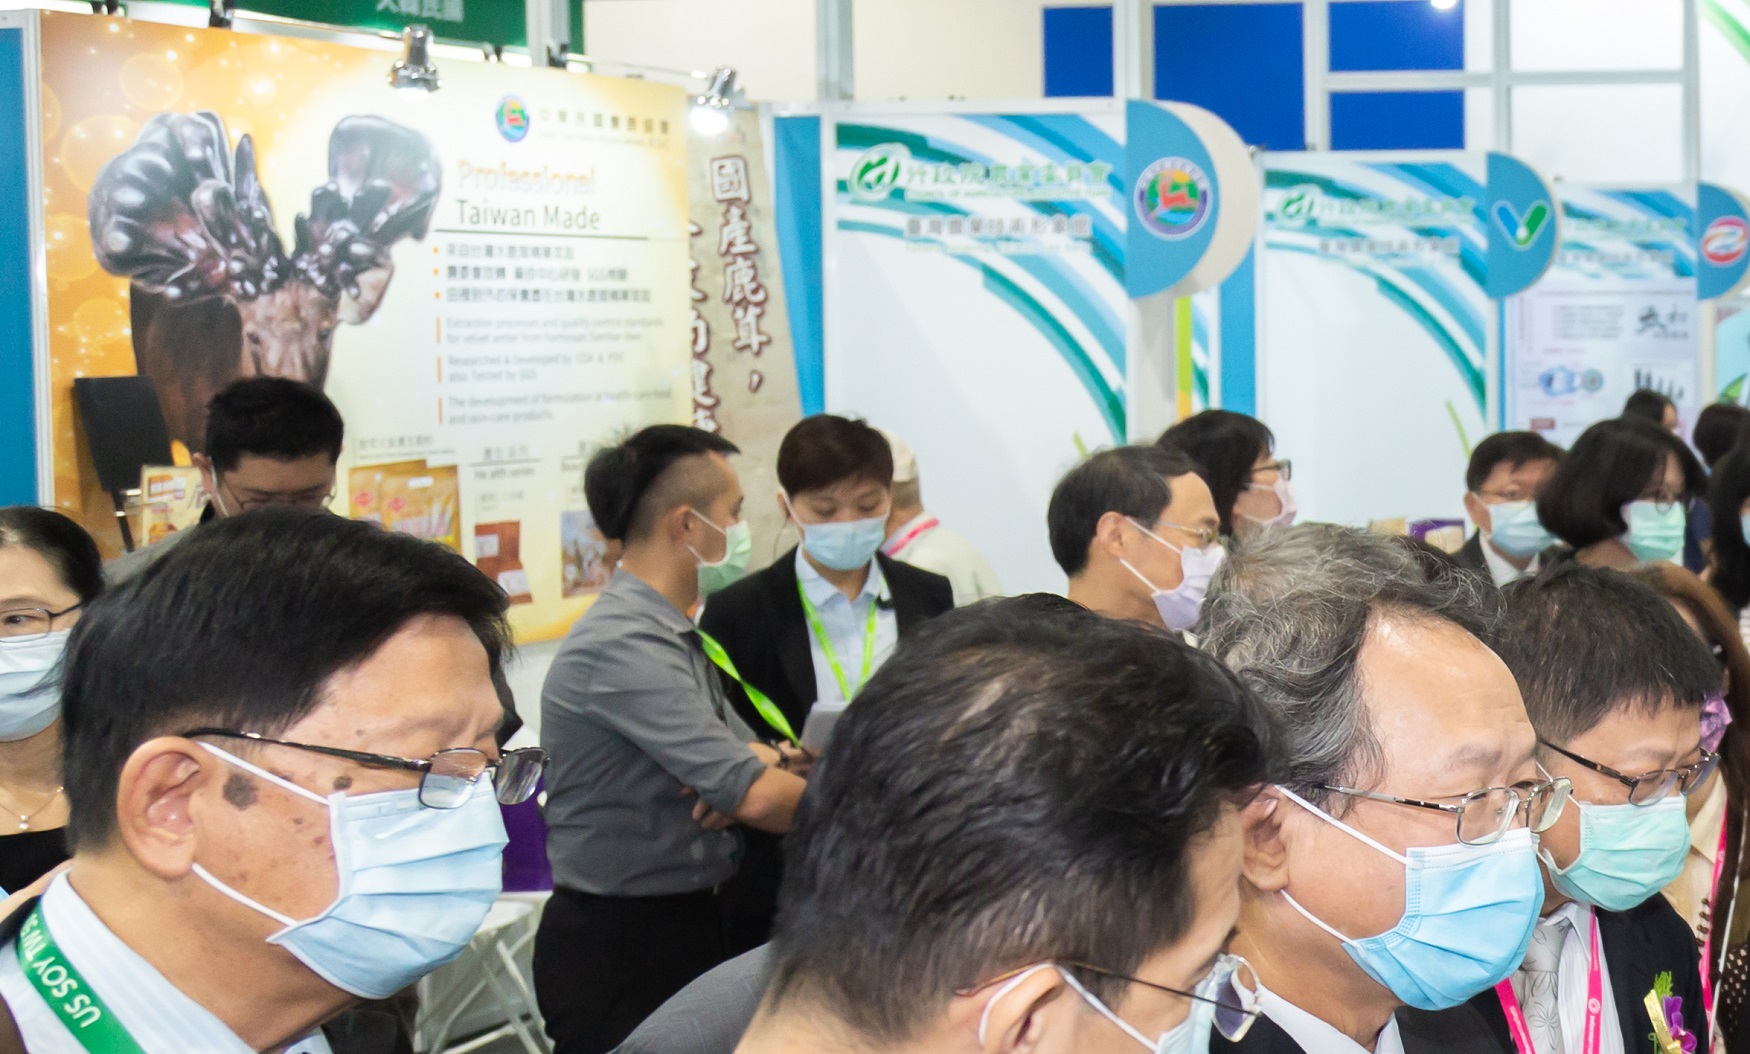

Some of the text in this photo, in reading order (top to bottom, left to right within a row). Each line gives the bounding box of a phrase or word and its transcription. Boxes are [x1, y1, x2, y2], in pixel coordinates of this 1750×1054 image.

[458, 160, 596, 195] Professional
[456, 200, 600, 231] Taiwan Made
[23, 929, 47, 961] TW
[32, 956, 78, 998] SOY
[64, 993, 101, 1029] US
